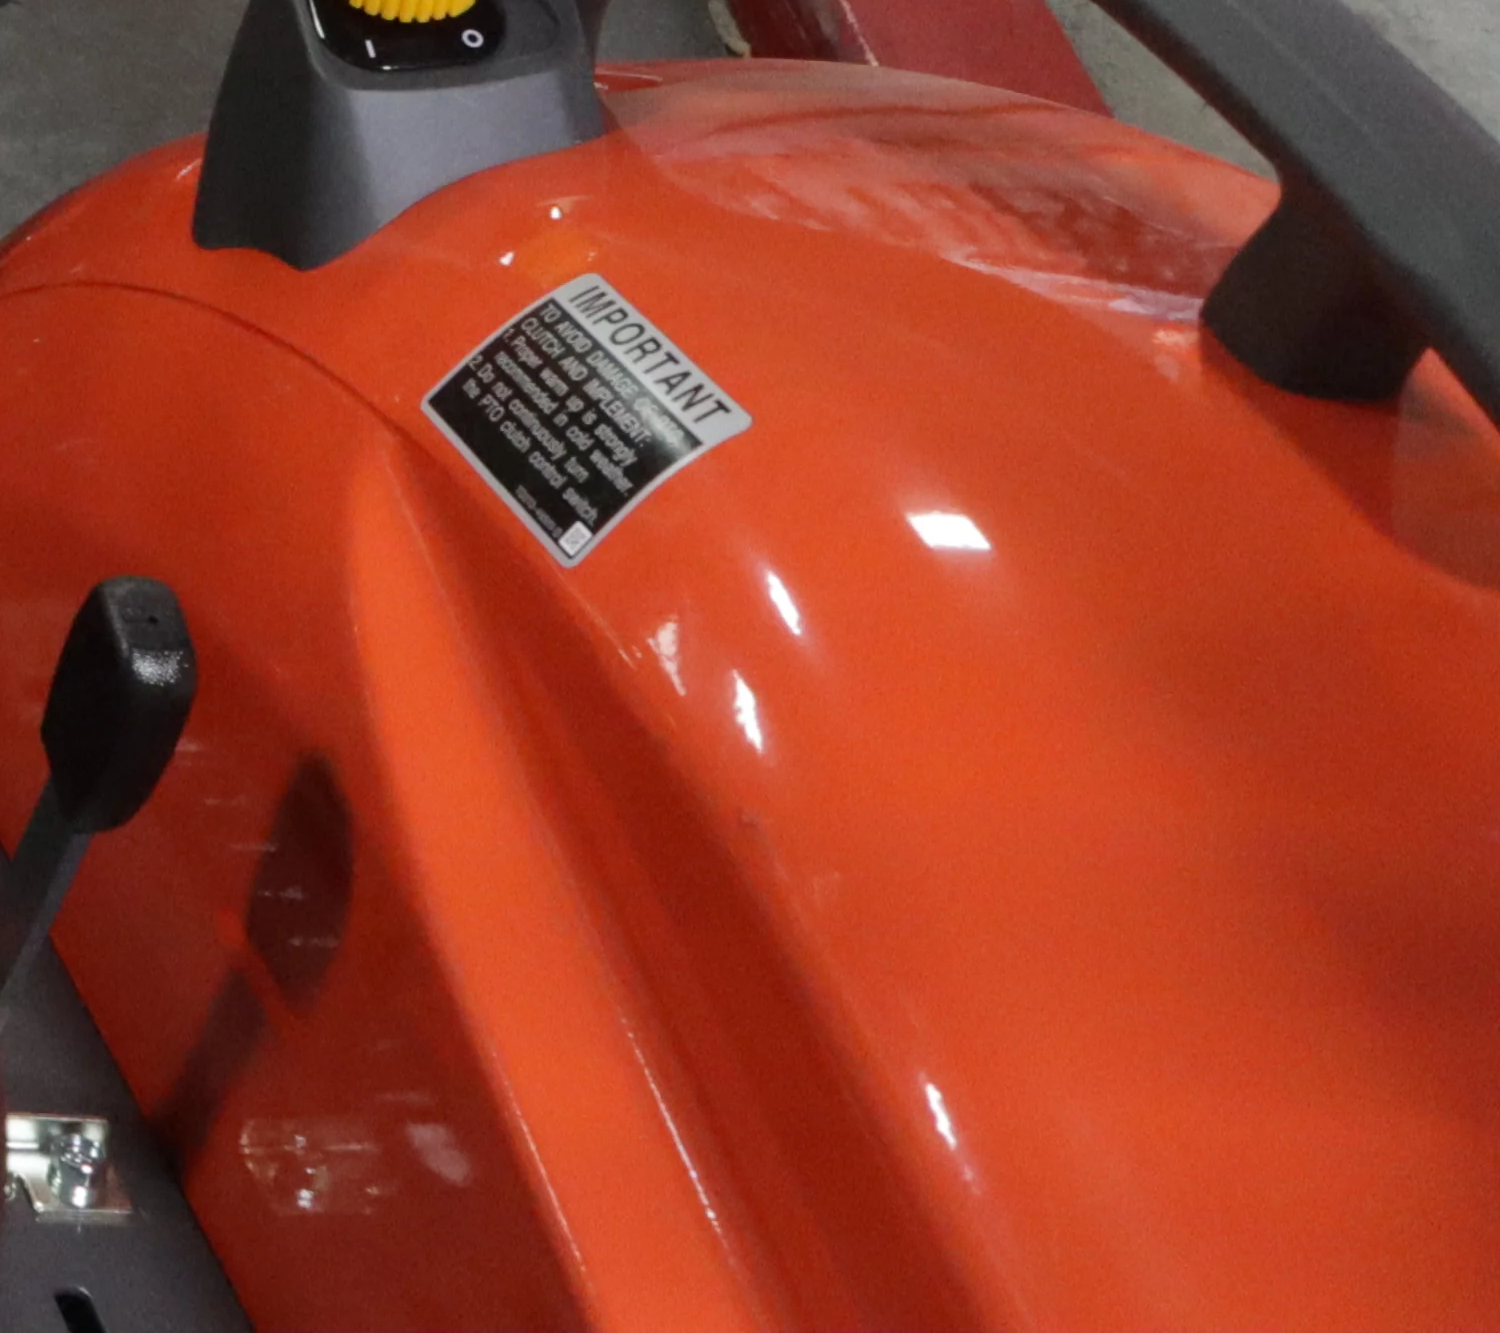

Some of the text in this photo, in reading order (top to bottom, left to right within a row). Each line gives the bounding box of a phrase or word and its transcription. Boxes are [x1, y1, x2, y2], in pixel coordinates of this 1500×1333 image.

[477, 365, 496, 382] Do
[492, 381, 512, 399] not
[521, 318, 654, 446] CLUTCH AND IMPLEMENT:
[539, 305, 560, 322] TO
[555, 320, 592, 353] AVOID
[586, 350, 638, 397] DAMAGE
[567, 285, 731, 425] IMPORTANT
[478, 396, 504, 421] PTO
[538, 368, 568, 395] warm
[563, 395, 584, 413] up
[581, 409, 599, 424] is
[591, 423, 639, 467] strongly
[566, 425, 592, 449] cold
